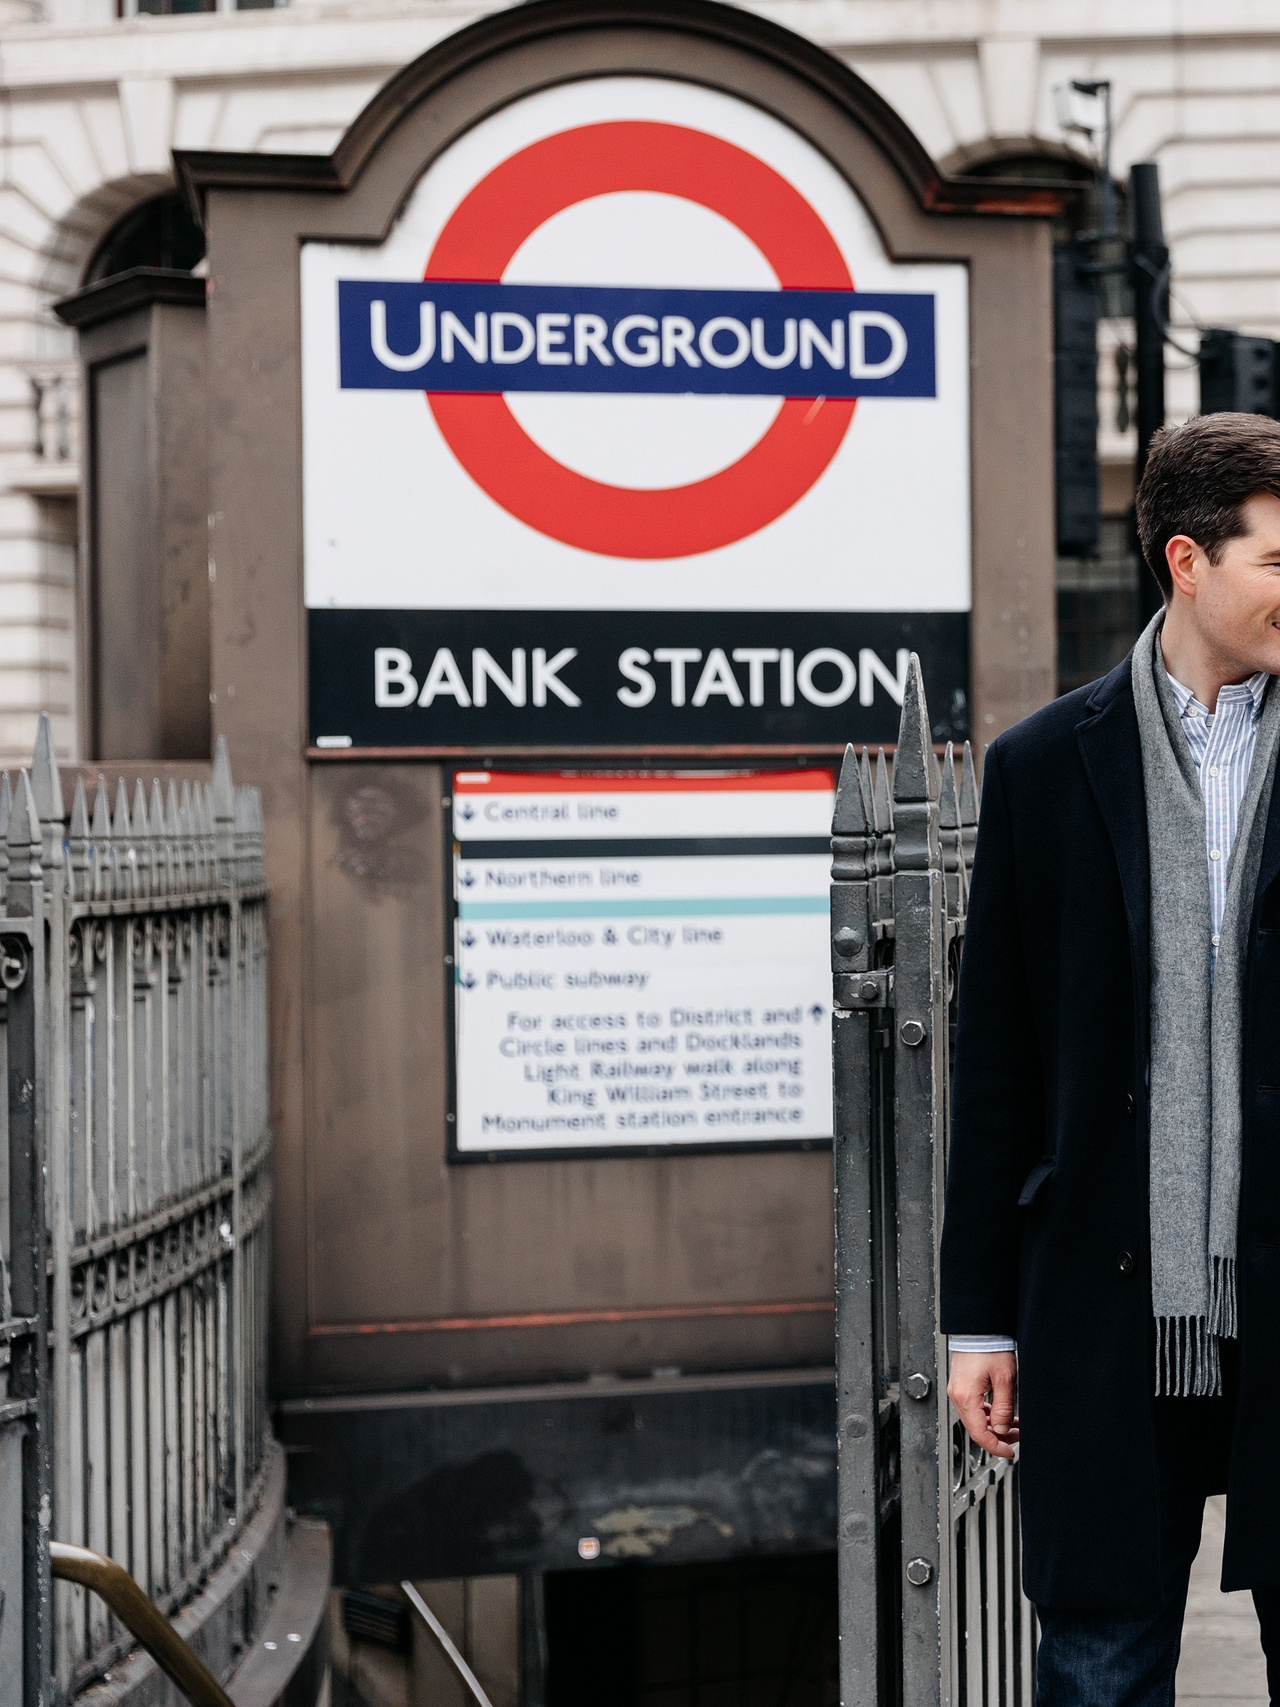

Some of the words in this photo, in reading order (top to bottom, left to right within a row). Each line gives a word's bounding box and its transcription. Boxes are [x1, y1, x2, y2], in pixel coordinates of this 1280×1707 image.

[369, 300, 908, 380] UNDERGROUND
[374, 647, 582, 708] BANK
[616, 646, 910, 708] STATION
[484, 802, 569, 822] Central
[578, 804, 619, 820] line
[485, 870, 593, 888] Northern
[600, 869, 641, 886] line
[486, 930, 594, 948] Waterloo
[602, 927, 619, 946] &
[627, 925, 674, 948] City
[682, 927, 723, 944] line
[486, 970, 553, 990] Public
[565, 970, 649, 990] subway
[507, 1011, 542, 1032] For
[551, 1013, 628, 1031] access
[636, 1012, 662, 1028] to
[670, 1007, 753, 1028] District
[762, 1006, 803, 1025] and
[499, 1037, 567, 1057] Circle
[574, 1038, 629, 1055] lines
[636, 1035, 678, 1054] and
[686, 1031, 803, 1052] Docklands
[524, 1062, 579, 1083] Light
[590, 1060, 676, 1081] Railway
[683, 1058, 734, 1076] walk
[743, 1057, 803, 1078] along
[548, 1085, 597, 1107] King
[605, 1085, 692, 1103] William
[700, 1081, 768, 1101] Street
[778, 1080, 804, 1098] to
[481, 1112, 606, 1133] Monument
[616, 1111, 698, 1129] station
[704, 1106, 804, 1126] entrance
